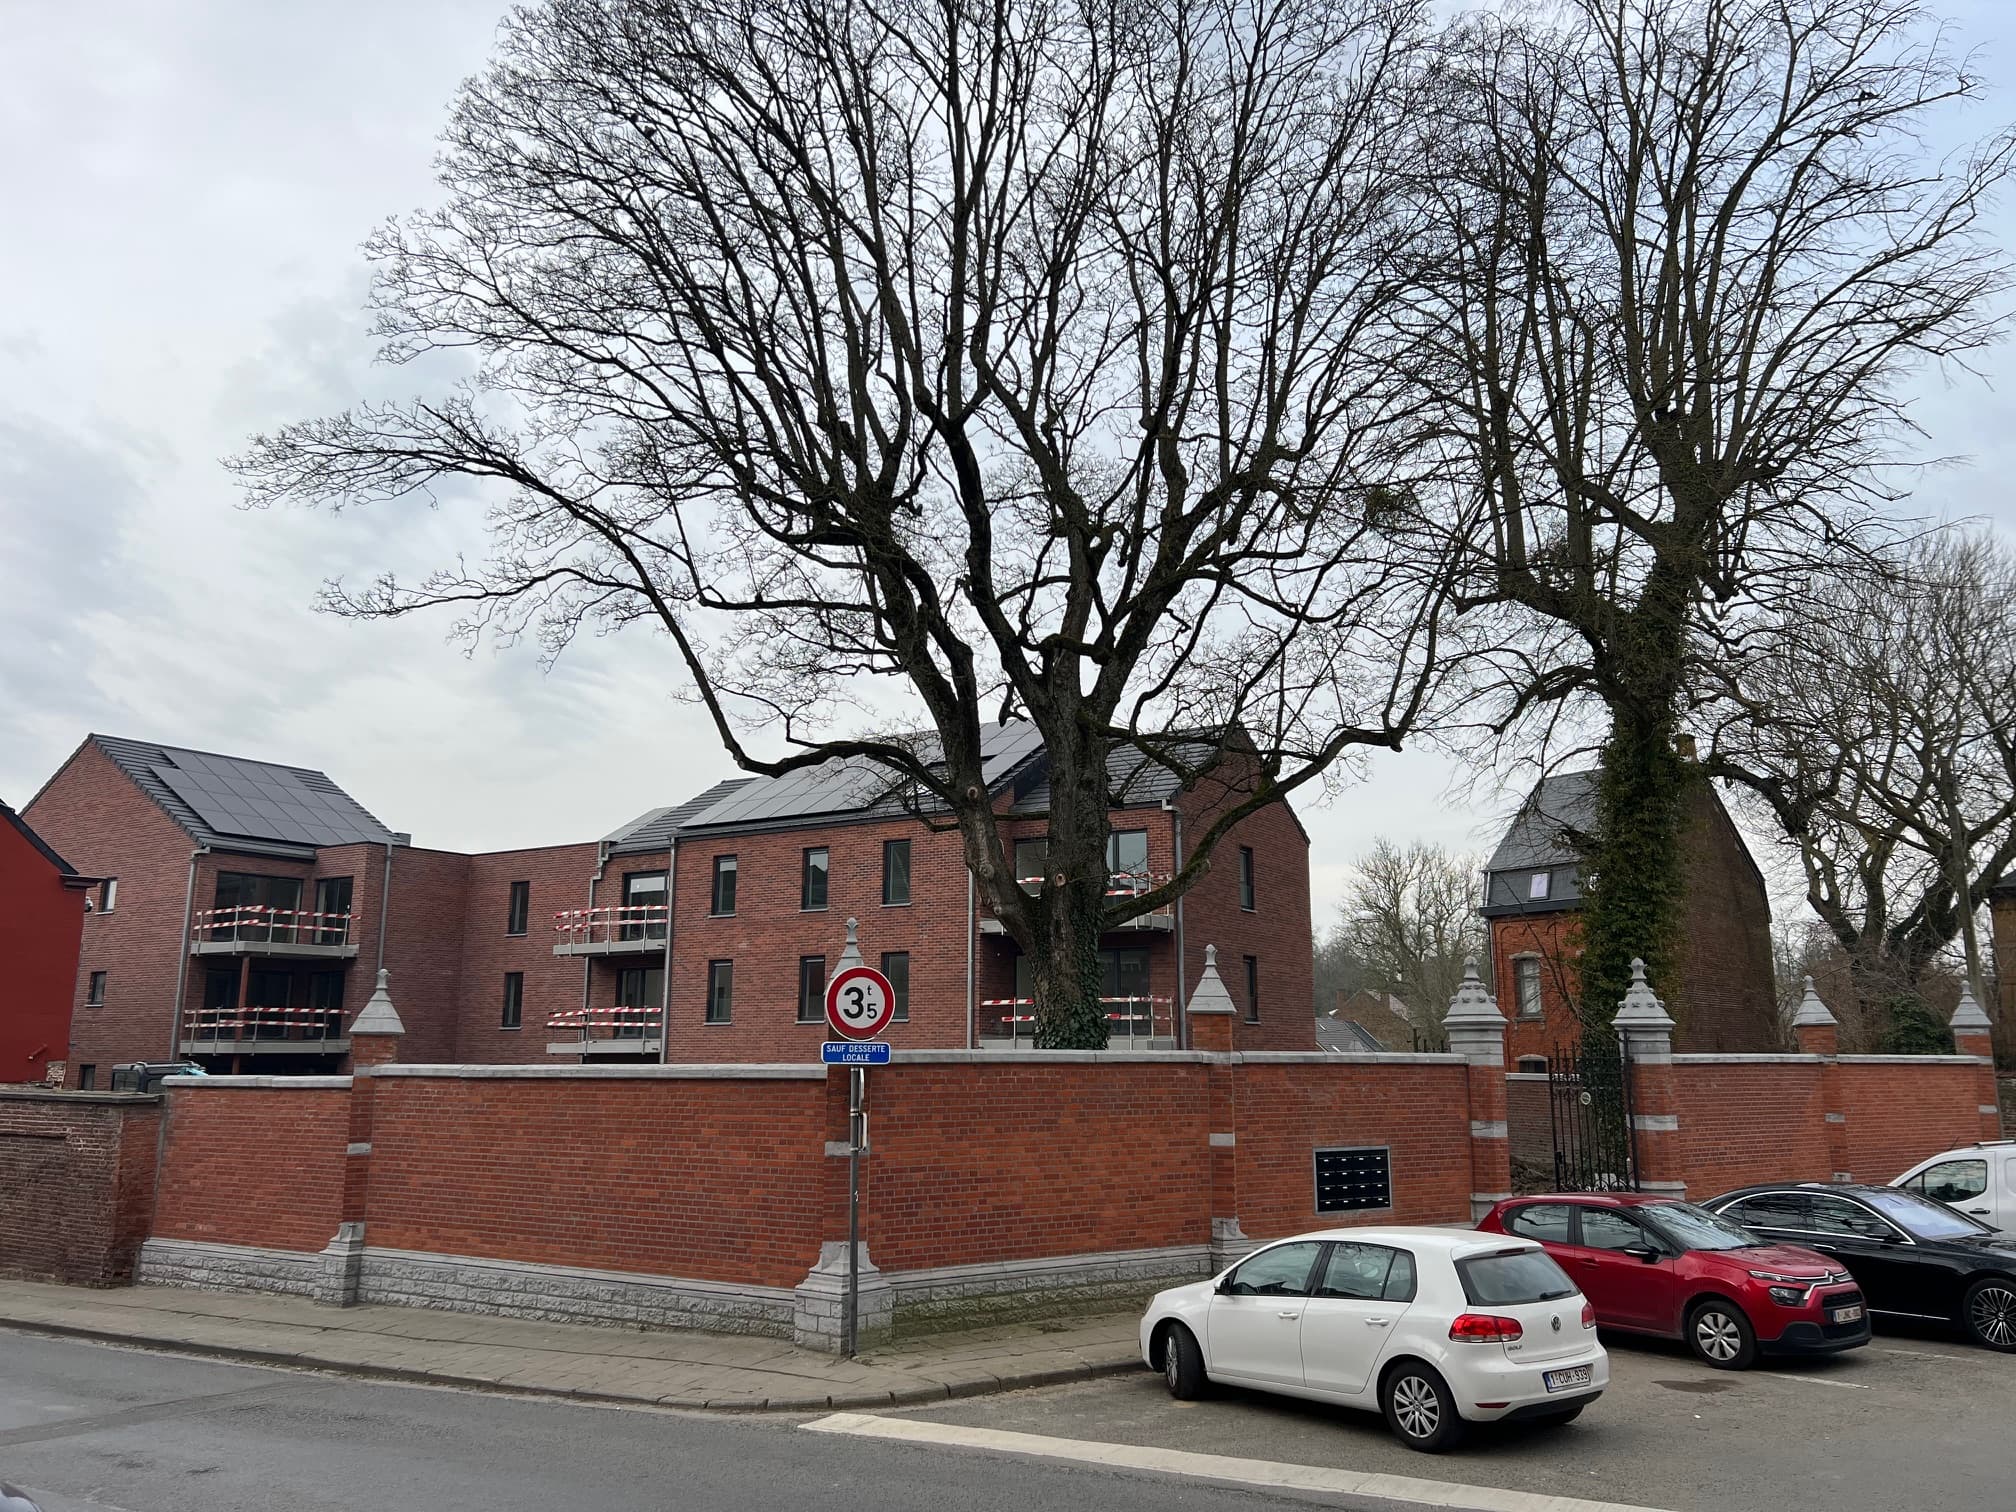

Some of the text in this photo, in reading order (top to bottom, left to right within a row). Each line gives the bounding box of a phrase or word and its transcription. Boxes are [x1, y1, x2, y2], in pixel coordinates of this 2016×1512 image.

[843, 986, 864, 1019] 3
[866, 1003, 878, 1019] 5
[826, 1045, 886, 1053] SAUF DESSERTE
[842, 1053, 870, 1062] LOCALE
